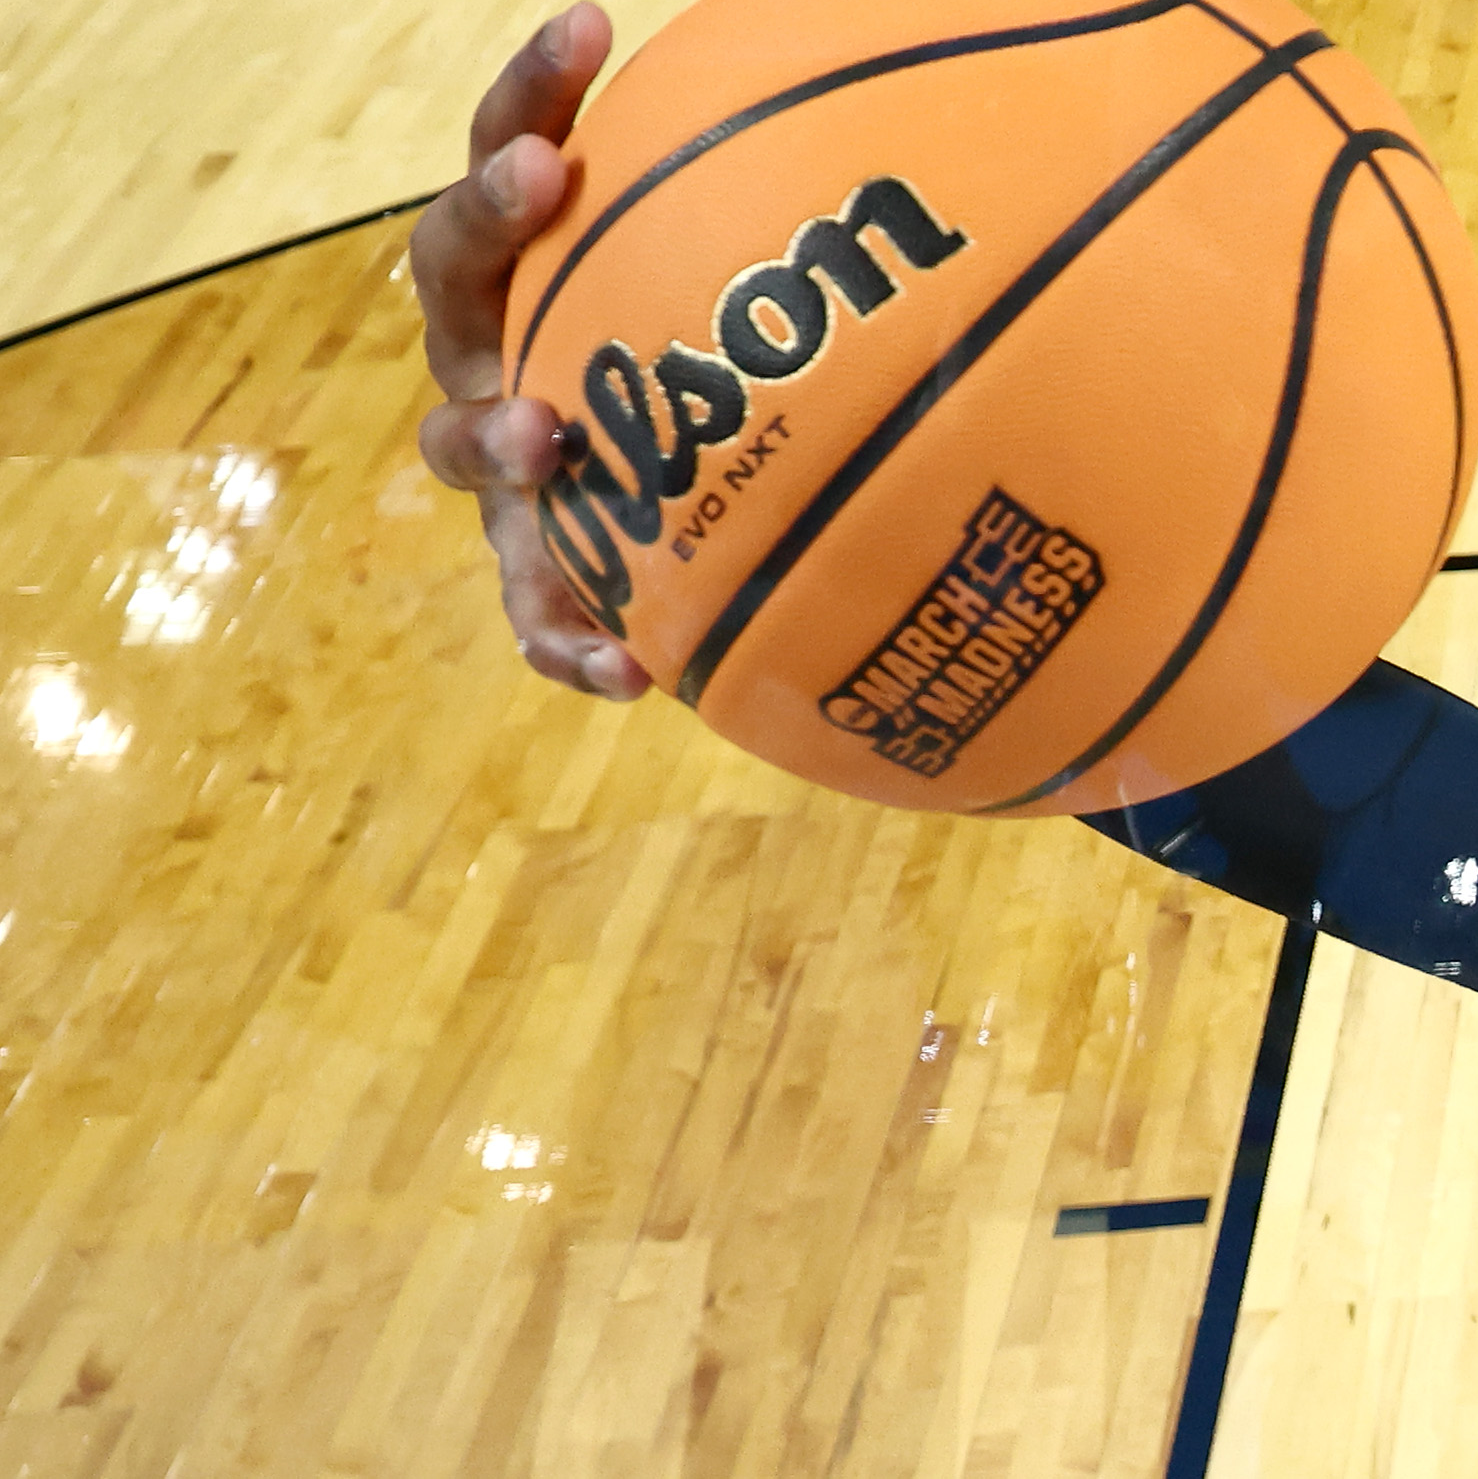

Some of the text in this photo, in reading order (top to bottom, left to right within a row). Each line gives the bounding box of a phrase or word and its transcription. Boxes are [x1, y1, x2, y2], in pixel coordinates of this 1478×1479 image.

[670, 413, 793, 563] EVO NXT
[851, 573, 992, 716] MARCH
[914, 534, 1095, 728] MADNESS
